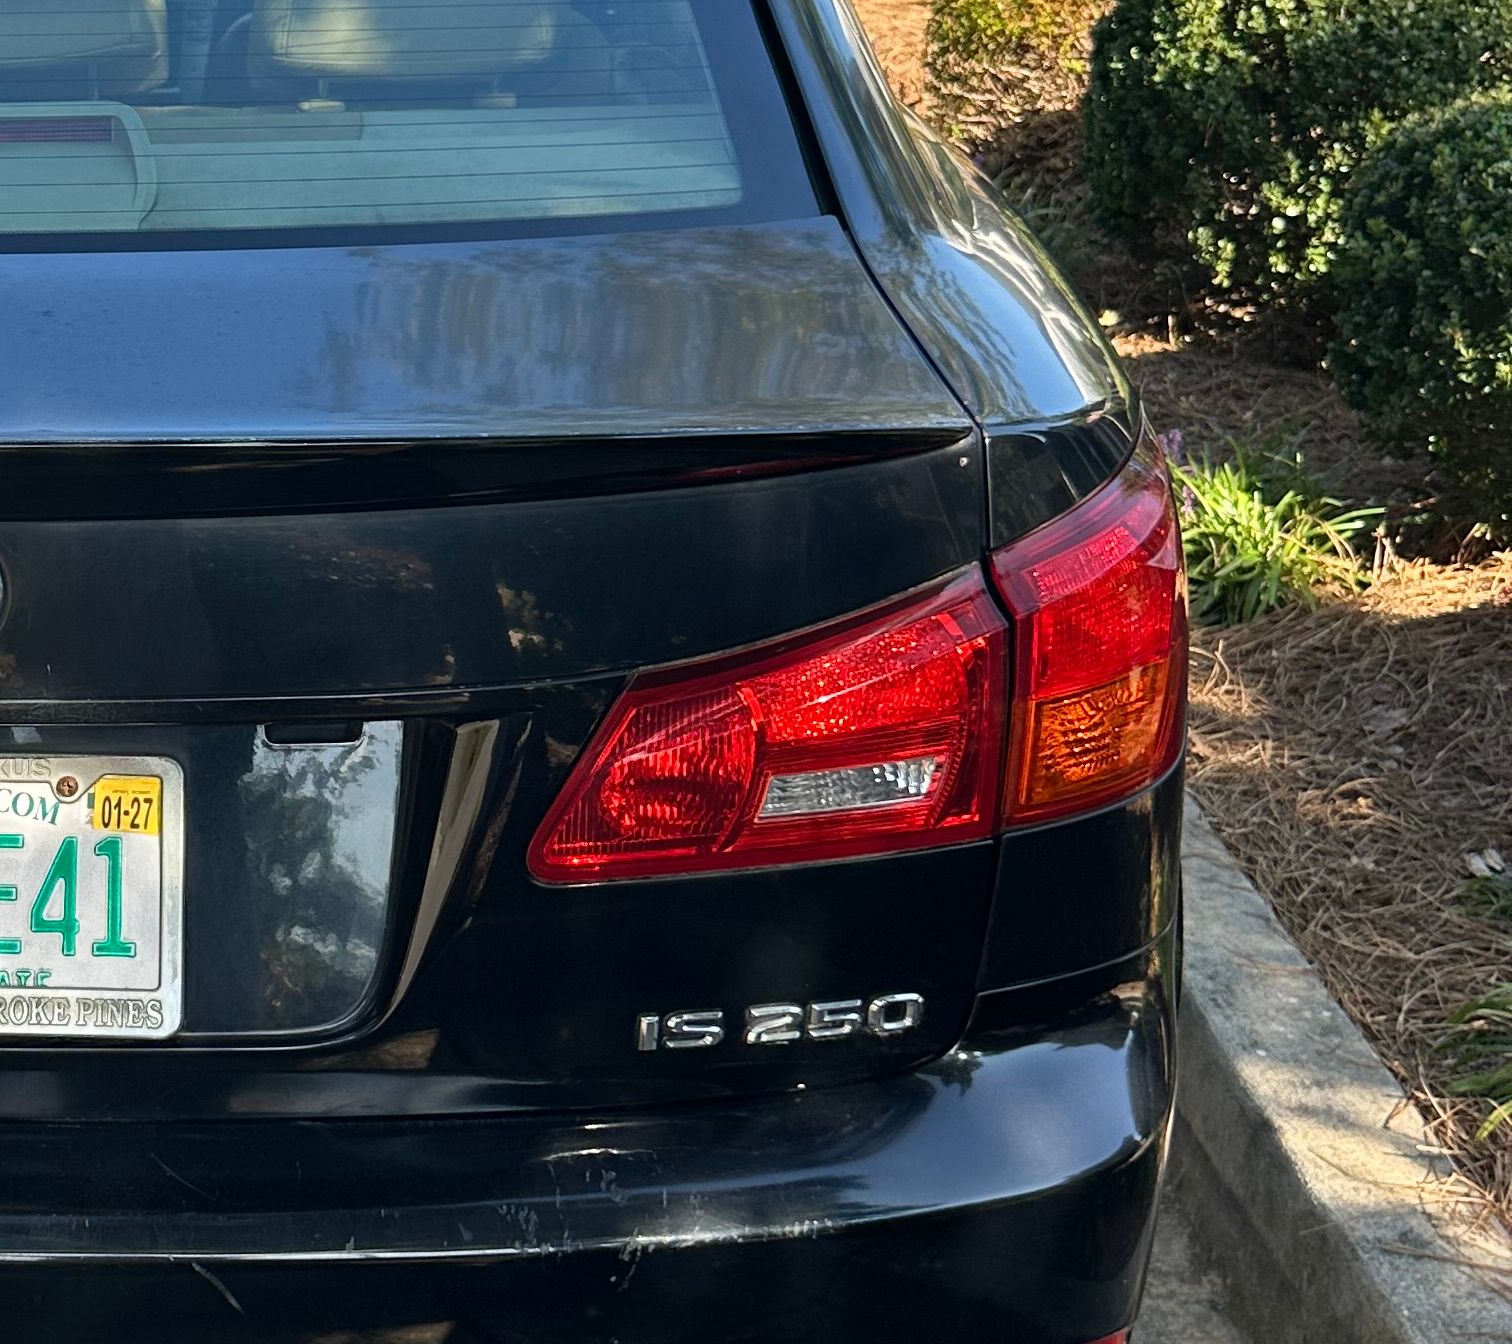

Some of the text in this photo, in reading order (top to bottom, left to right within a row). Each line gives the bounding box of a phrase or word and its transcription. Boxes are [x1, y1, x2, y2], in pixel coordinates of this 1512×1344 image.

[101, 795, 154, 830] 01-27
[76, 997, 164, 1029] PINES
[636, 992, 925, 1051] IS 250
